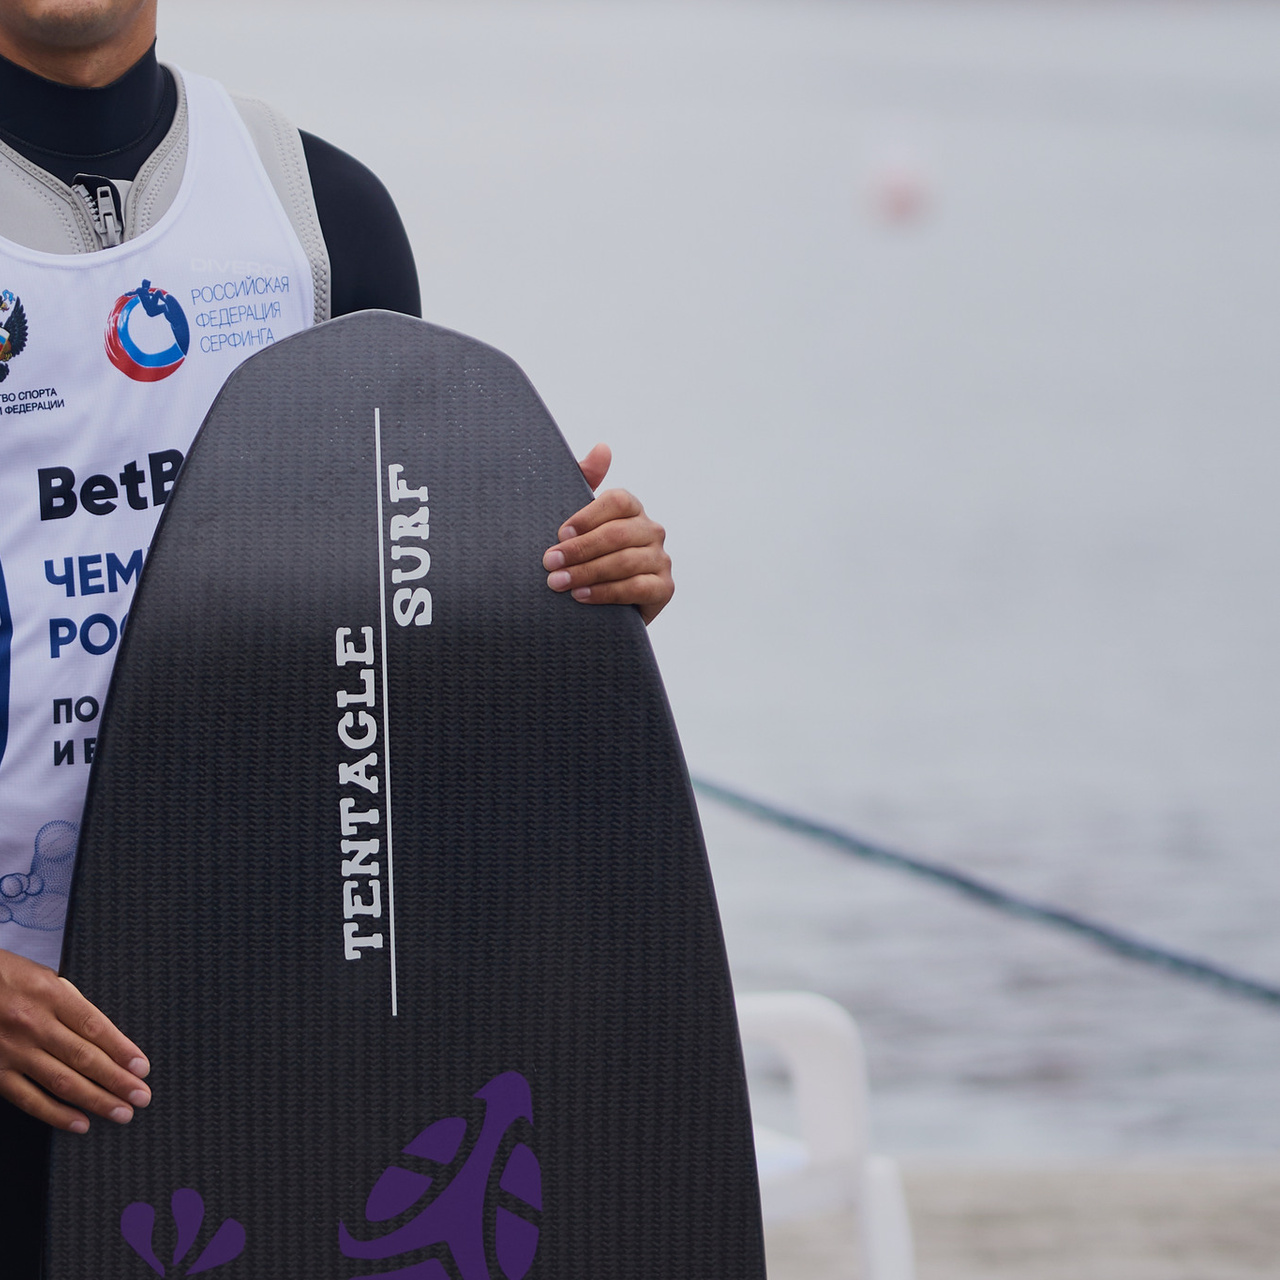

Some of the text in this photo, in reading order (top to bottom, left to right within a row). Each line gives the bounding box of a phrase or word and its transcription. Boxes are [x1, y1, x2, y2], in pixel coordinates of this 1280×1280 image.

[191, 276, 290, 305] РОССИЙСКАЯ
[195, 301, 281, 329] ФЕДЕРАЦИЯ
[200, 327, 275, 353] СЕРФИНГА
[4, 399, 65, 414] ФЕДЕРАЦИИ
[18, 387, 58, 401] СПОРТА
[38, 449, 185, 521] BetB
[388, 464, 433, 626] SURF
[44, 547, 150, 598] ЧЕМ
[49, 612, 128, 658] РО
[53, 695, 99, 724] ПО
[54, 739, 74, 766] И
